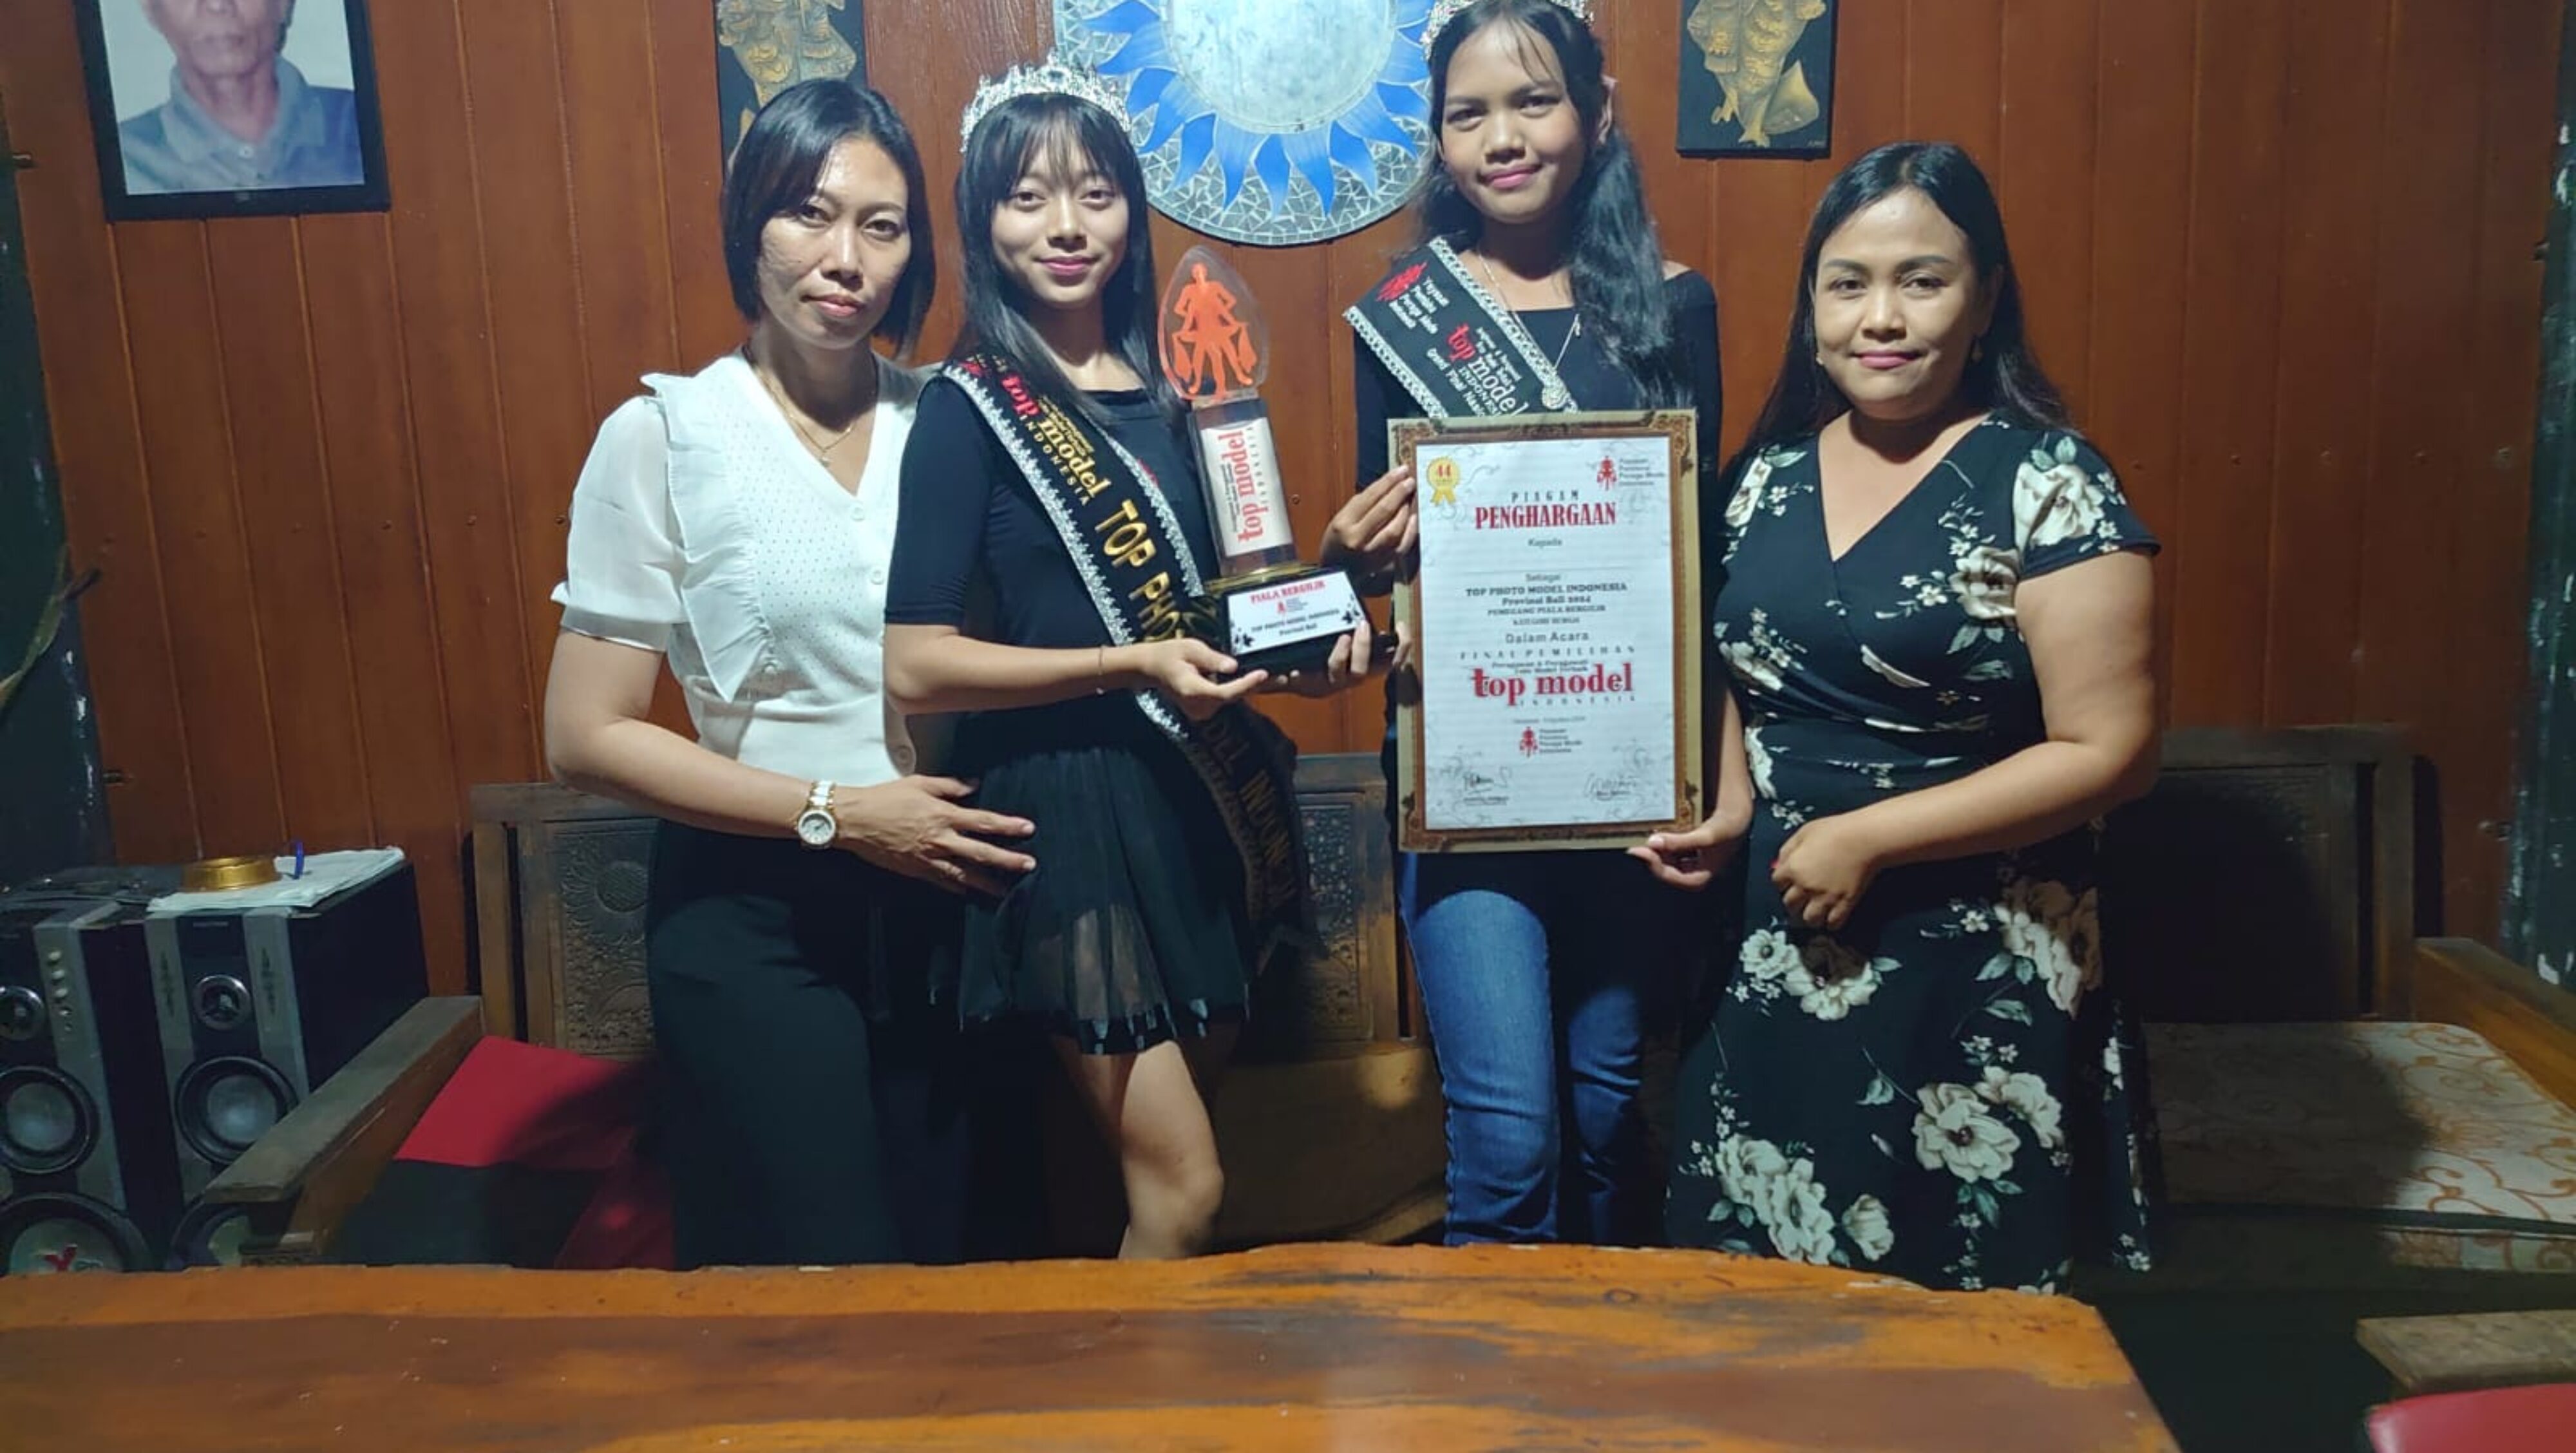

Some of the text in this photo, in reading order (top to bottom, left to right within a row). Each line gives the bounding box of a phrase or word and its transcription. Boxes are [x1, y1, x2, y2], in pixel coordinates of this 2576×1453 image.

[1446, 323, 1477, 361] top
[1000, 374, 1040, 416] top
[1037, 418, 1112, 498] model
[1019, 414, 1089, 506] INDONESIA
[1218, 430, 1255, 497] model
[1237, 503, 1269, 542] top
[1475, 502, 1616, 530] PENGHARGAAN
[1095, 499, 1185, 642] TOP PHO
[1465, 582, 1627, 596] TOP PHOTO MODEL INDONESIA
[1250, 589, 1281, 603] PIALA
[1506, 632, 1589, 644] Dalam Acara
[1470, 662, 1634, 707] top model
